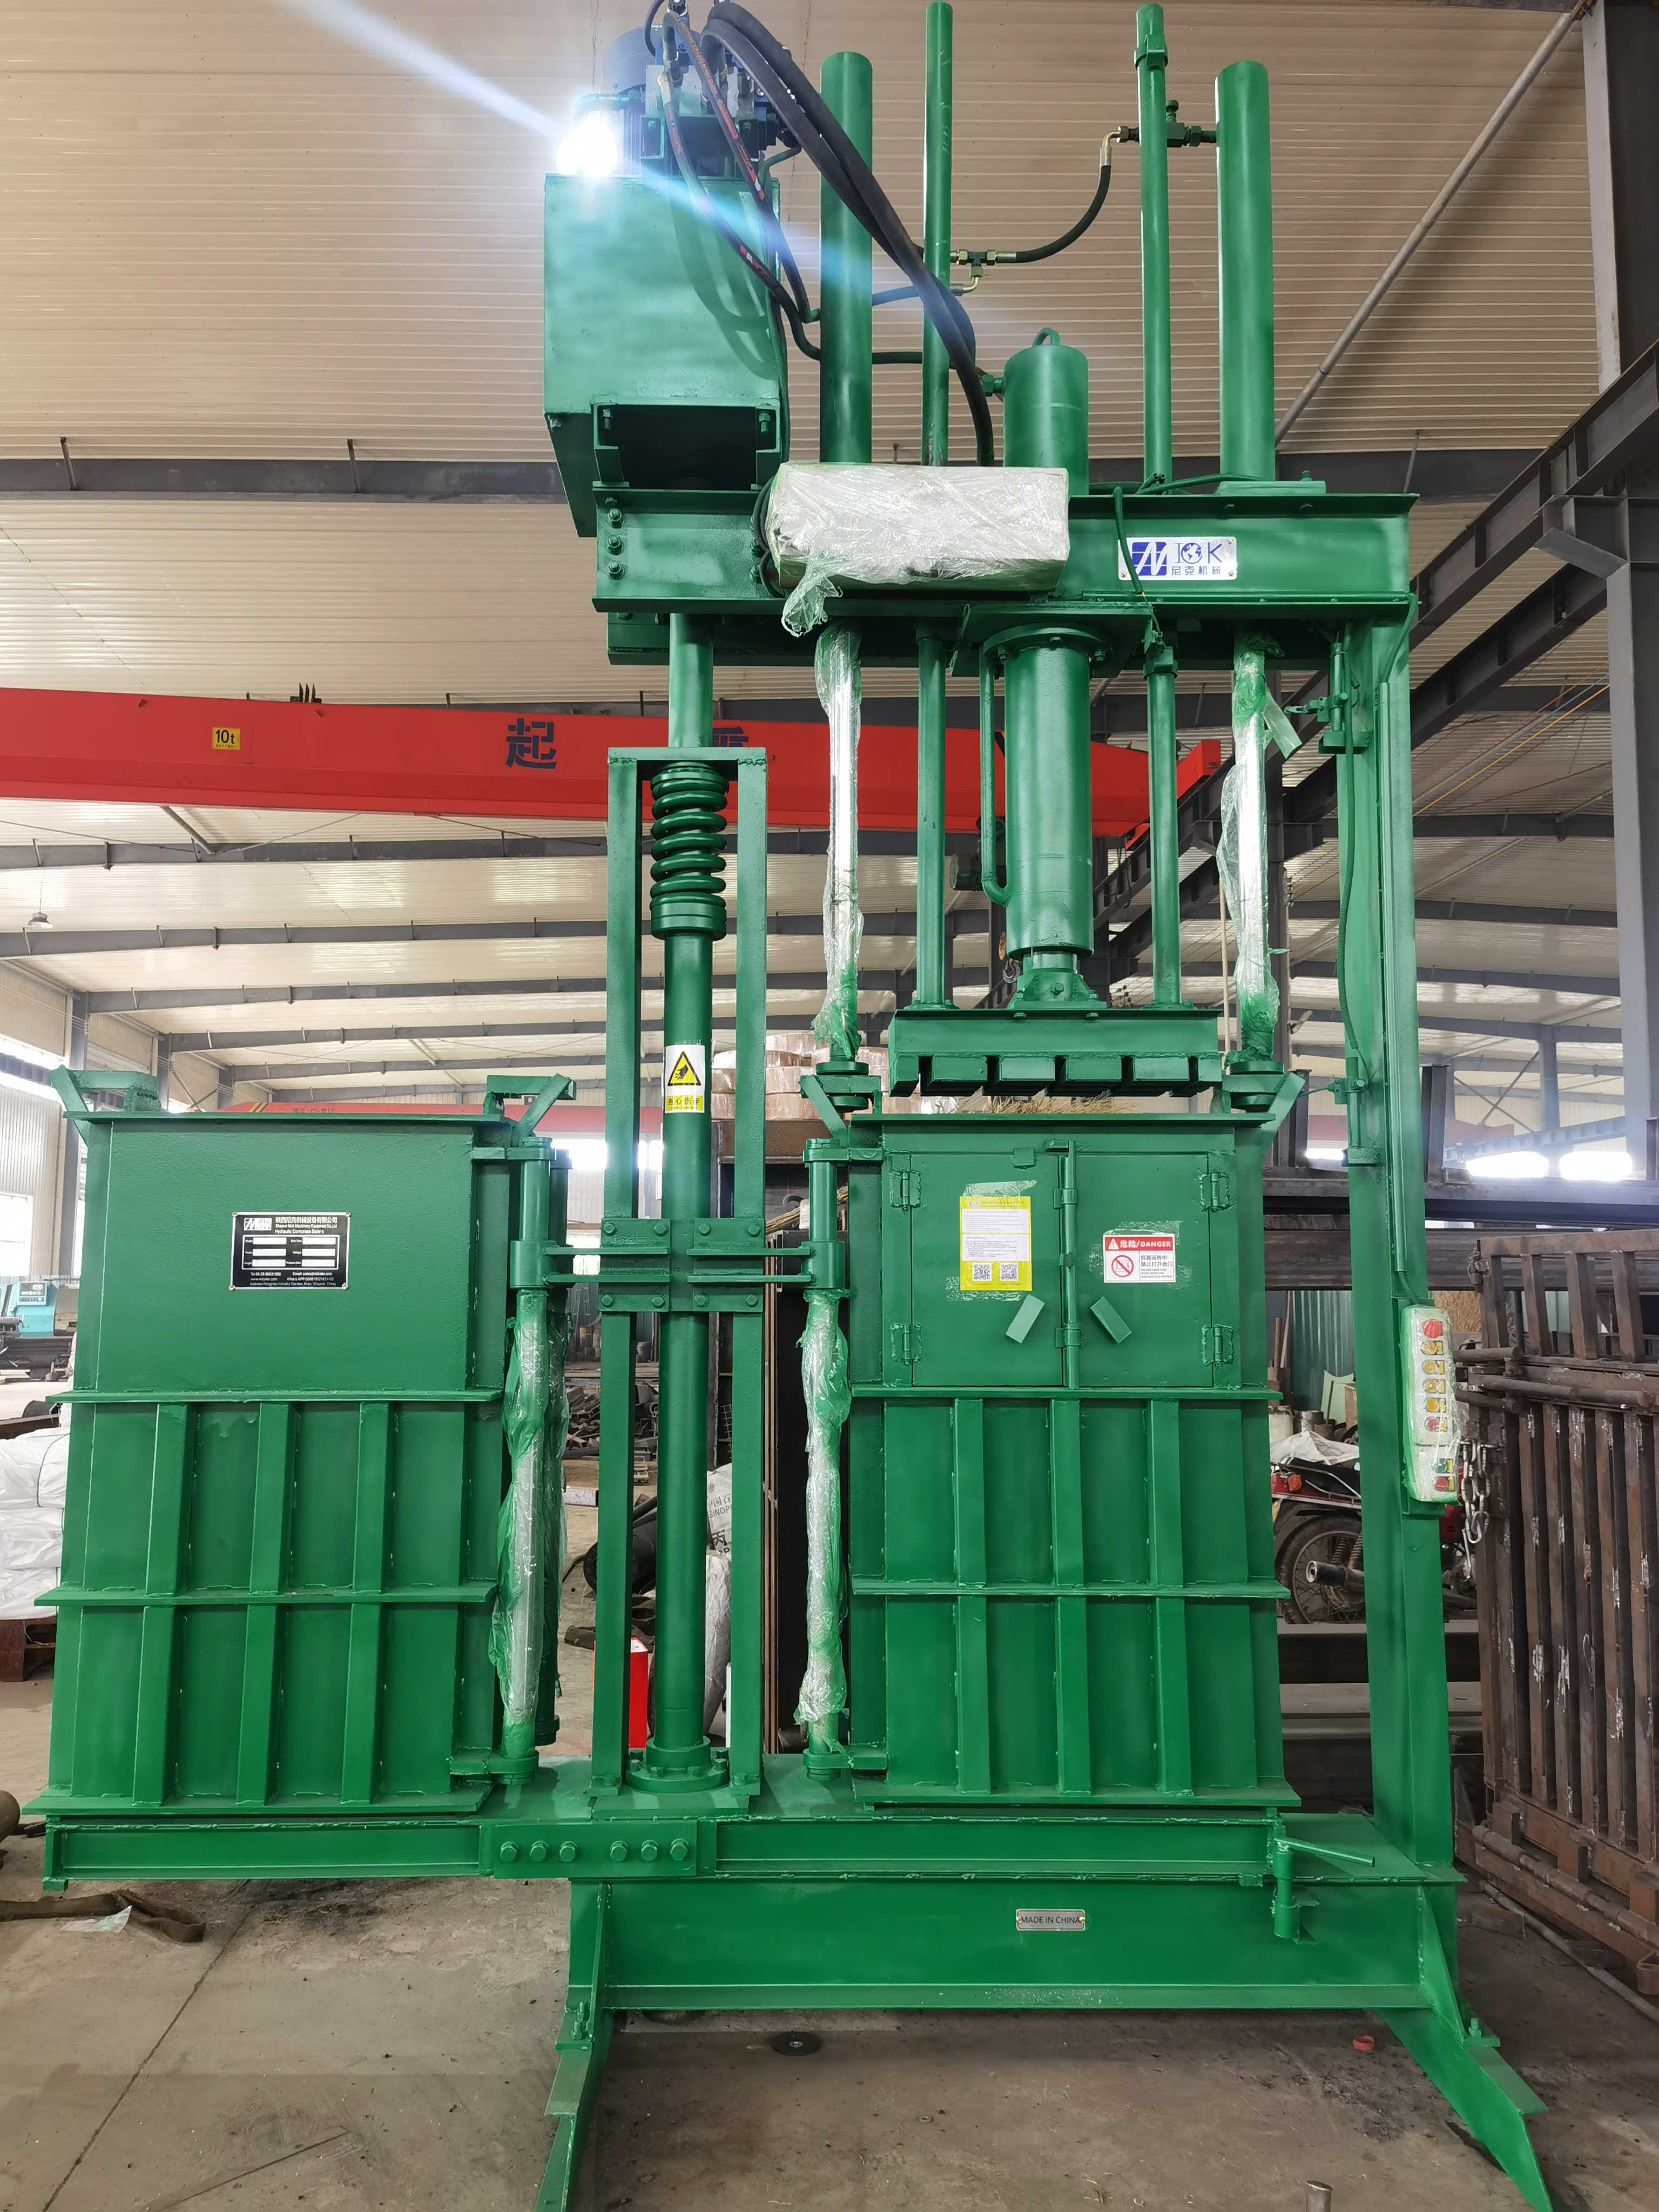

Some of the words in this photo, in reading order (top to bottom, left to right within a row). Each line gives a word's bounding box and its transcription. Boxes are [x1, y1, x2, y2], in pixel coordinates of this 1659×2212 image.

[1171, 565, 1221, 576] 尼克机械
[215, 729, 235, 744] 10t
